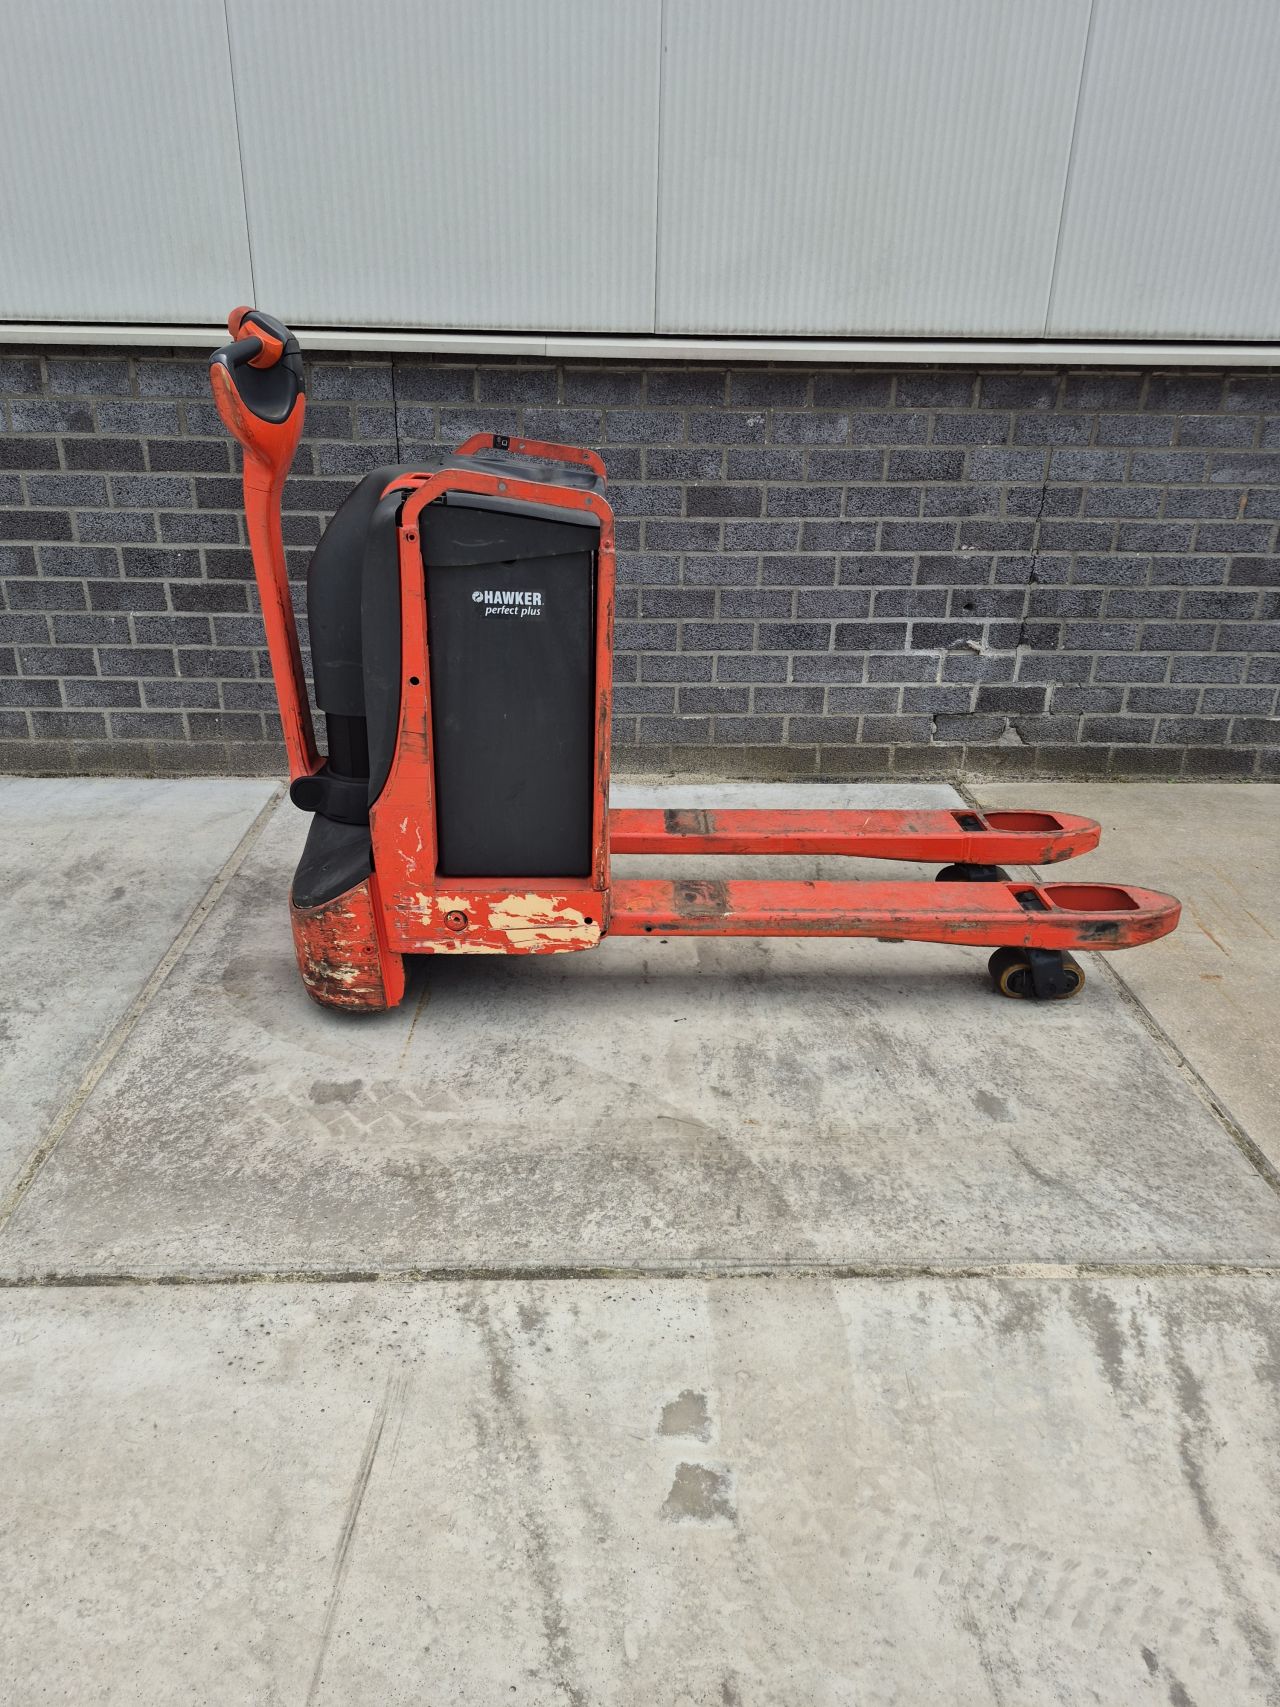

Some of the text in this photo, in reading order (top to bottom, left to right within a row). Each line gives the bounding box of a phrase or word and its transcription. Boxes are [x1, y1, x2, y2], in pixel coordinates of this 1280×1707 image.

[484, 590, 542, 606] HAWKER
[484, 605, 541, 618] perfect plus
